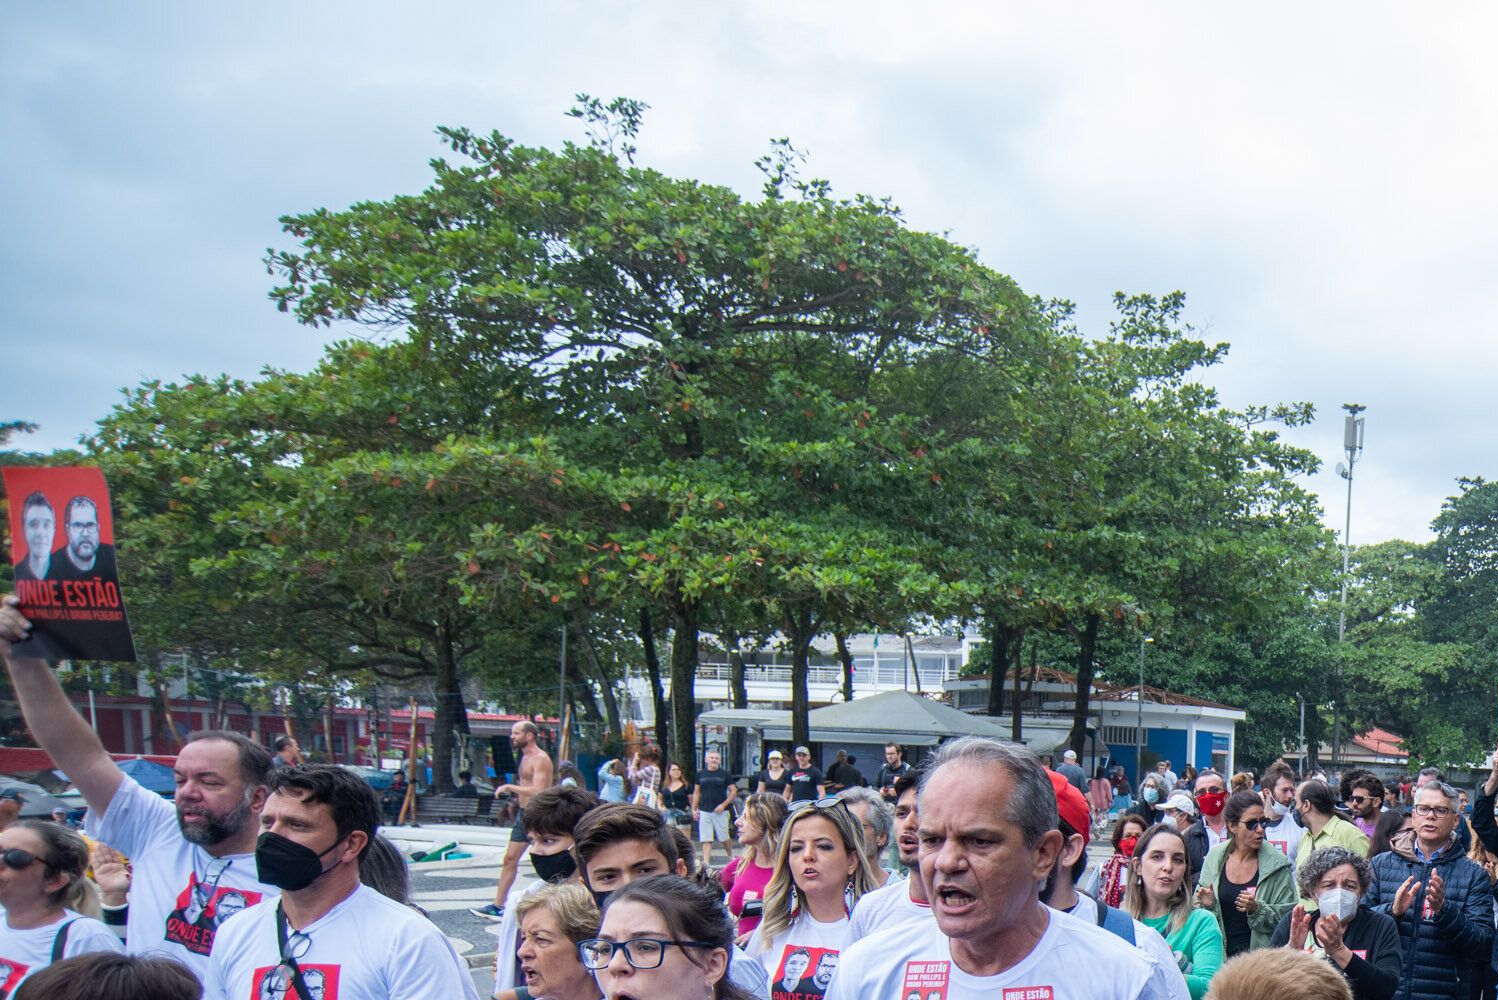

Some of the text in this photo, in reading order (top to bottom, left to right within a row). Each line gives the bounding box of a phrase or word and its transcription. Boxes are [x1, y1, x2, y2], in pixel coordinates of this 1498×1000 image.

[17, 577, 118, 608] ONDE ESTÃO
[167, 918, 200, 942] ONDE
[908, 962, 948, 973] ONDE ESTÃO
[1006, 987, 1050, 1000] ONDE ESTÃO
